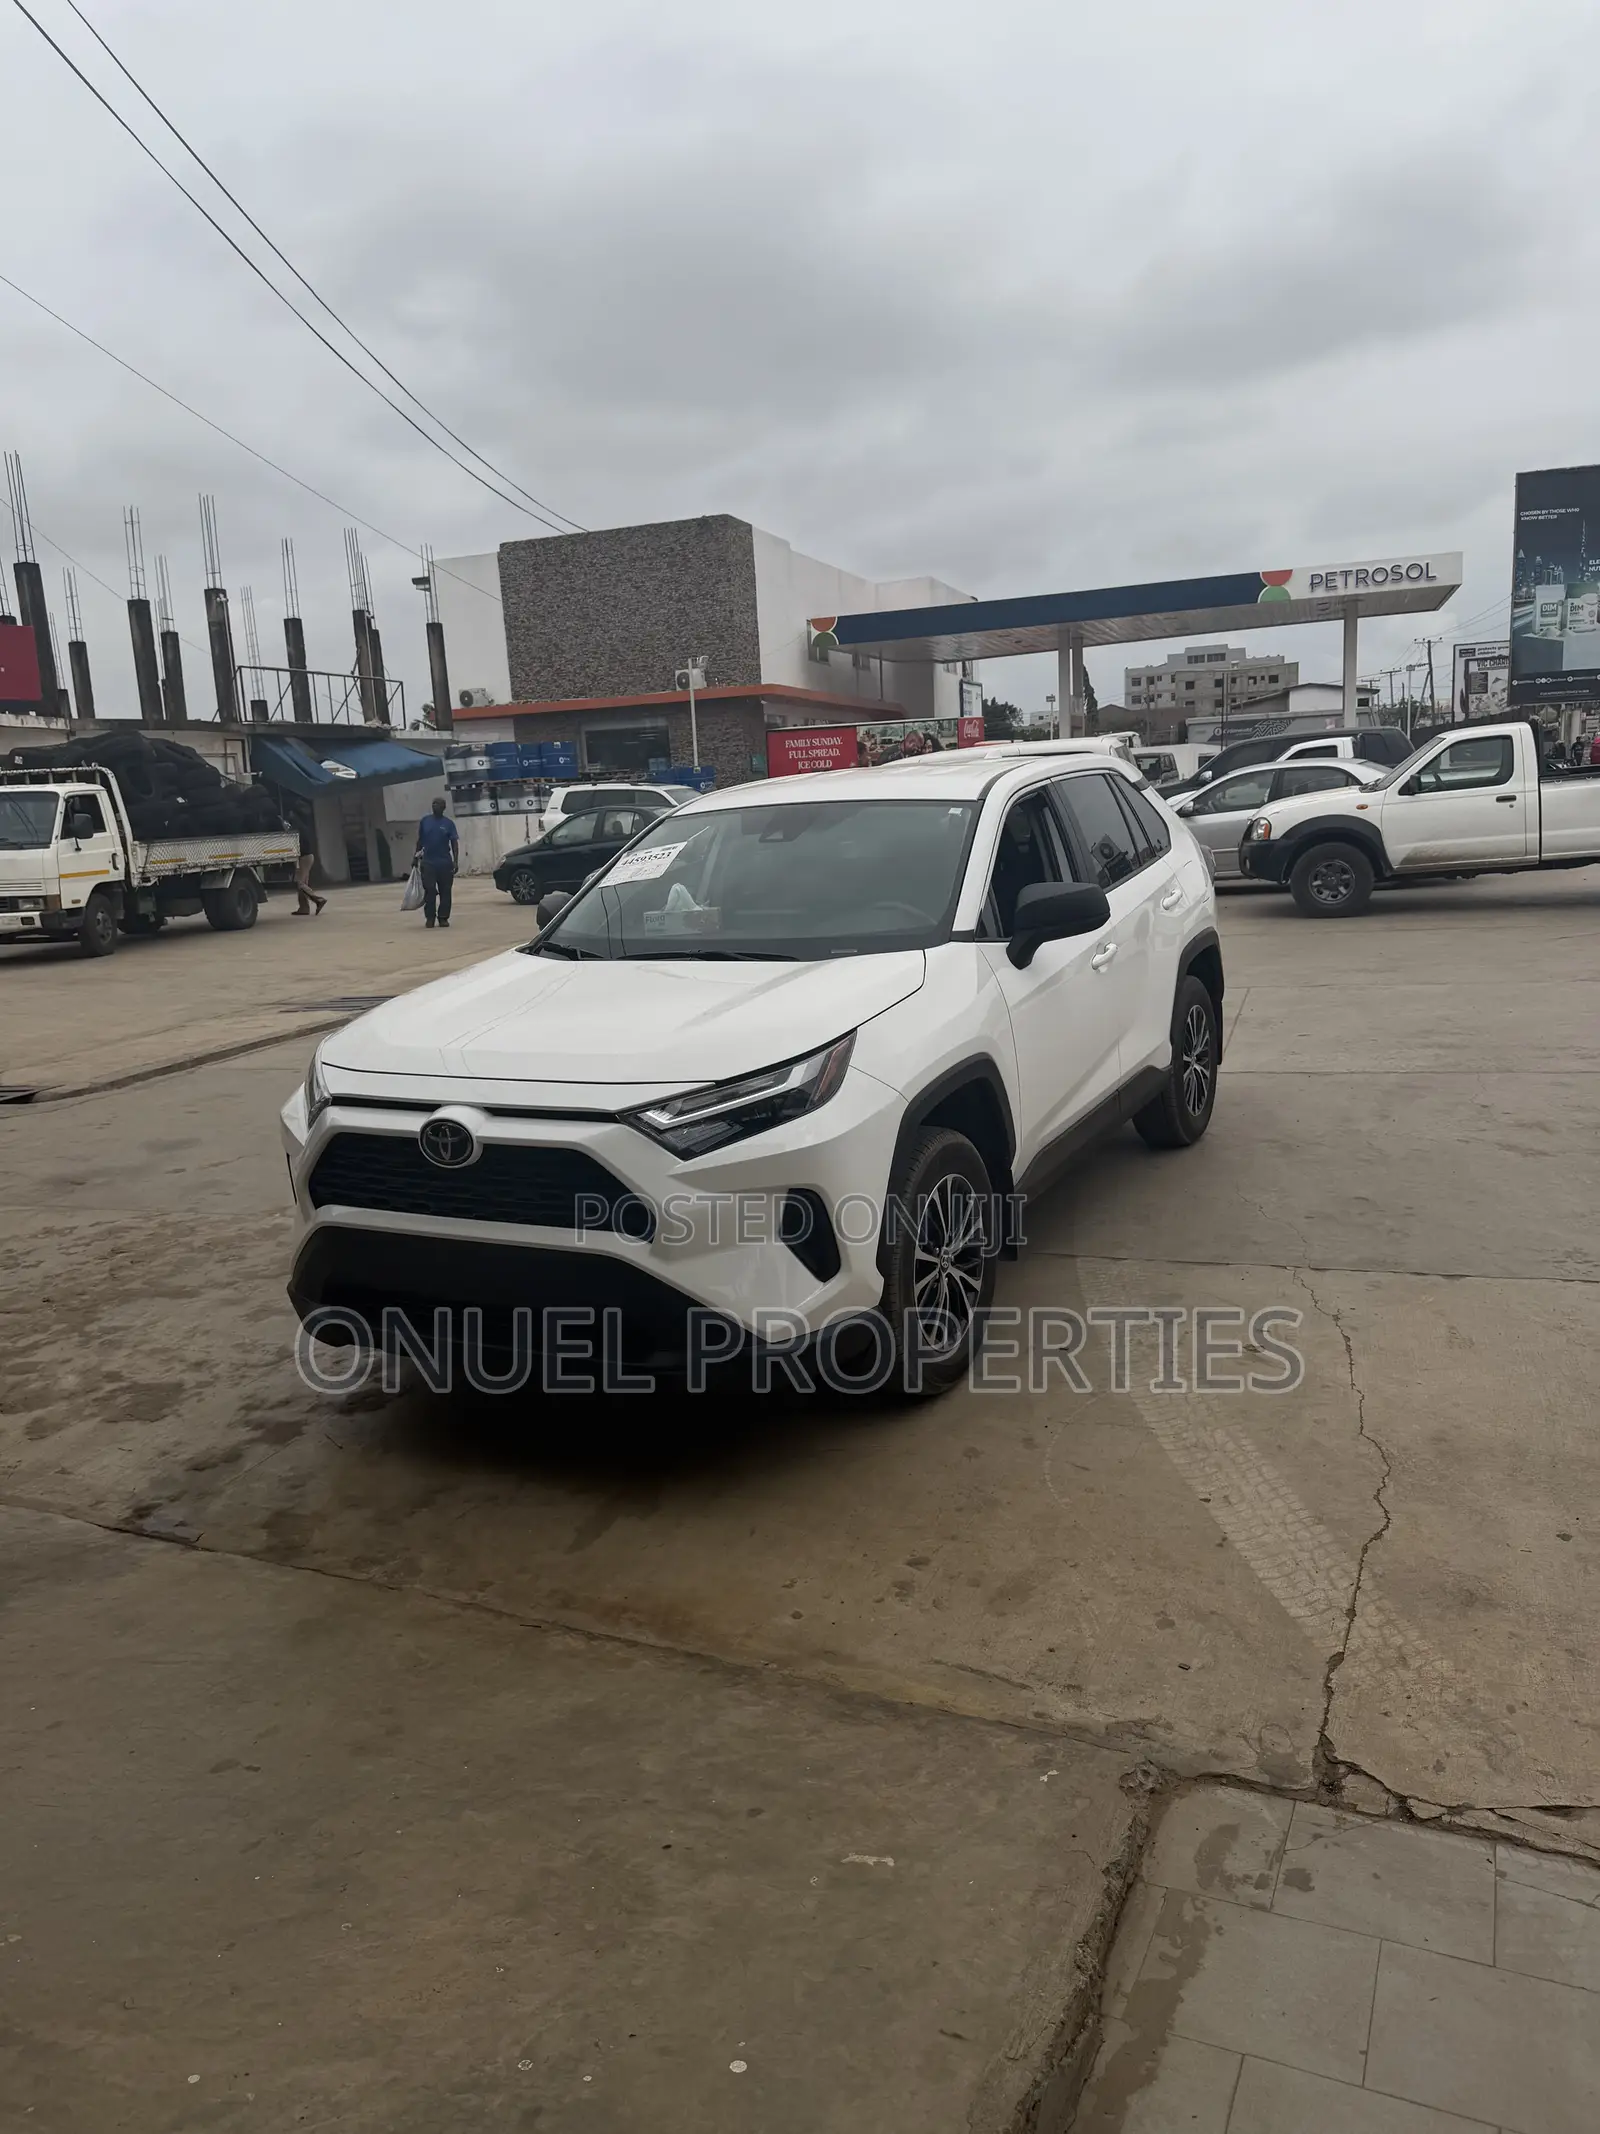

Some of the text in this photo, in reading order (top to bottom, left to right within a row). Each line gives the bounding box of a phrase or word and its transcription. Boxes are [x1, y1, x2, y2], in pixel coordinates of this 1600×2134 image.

[1309, 562, 1436, 592] PETROSOL
[1542, 604, 1557, 612] DIM
[1570, 604, 1583, 612] DIM
[785, 736, 843, 748] FAMILY SUNDAY.
[789, 748, 841, 759] FULL SPREAD.
[798, 760, 832, 769] ICE COLD
